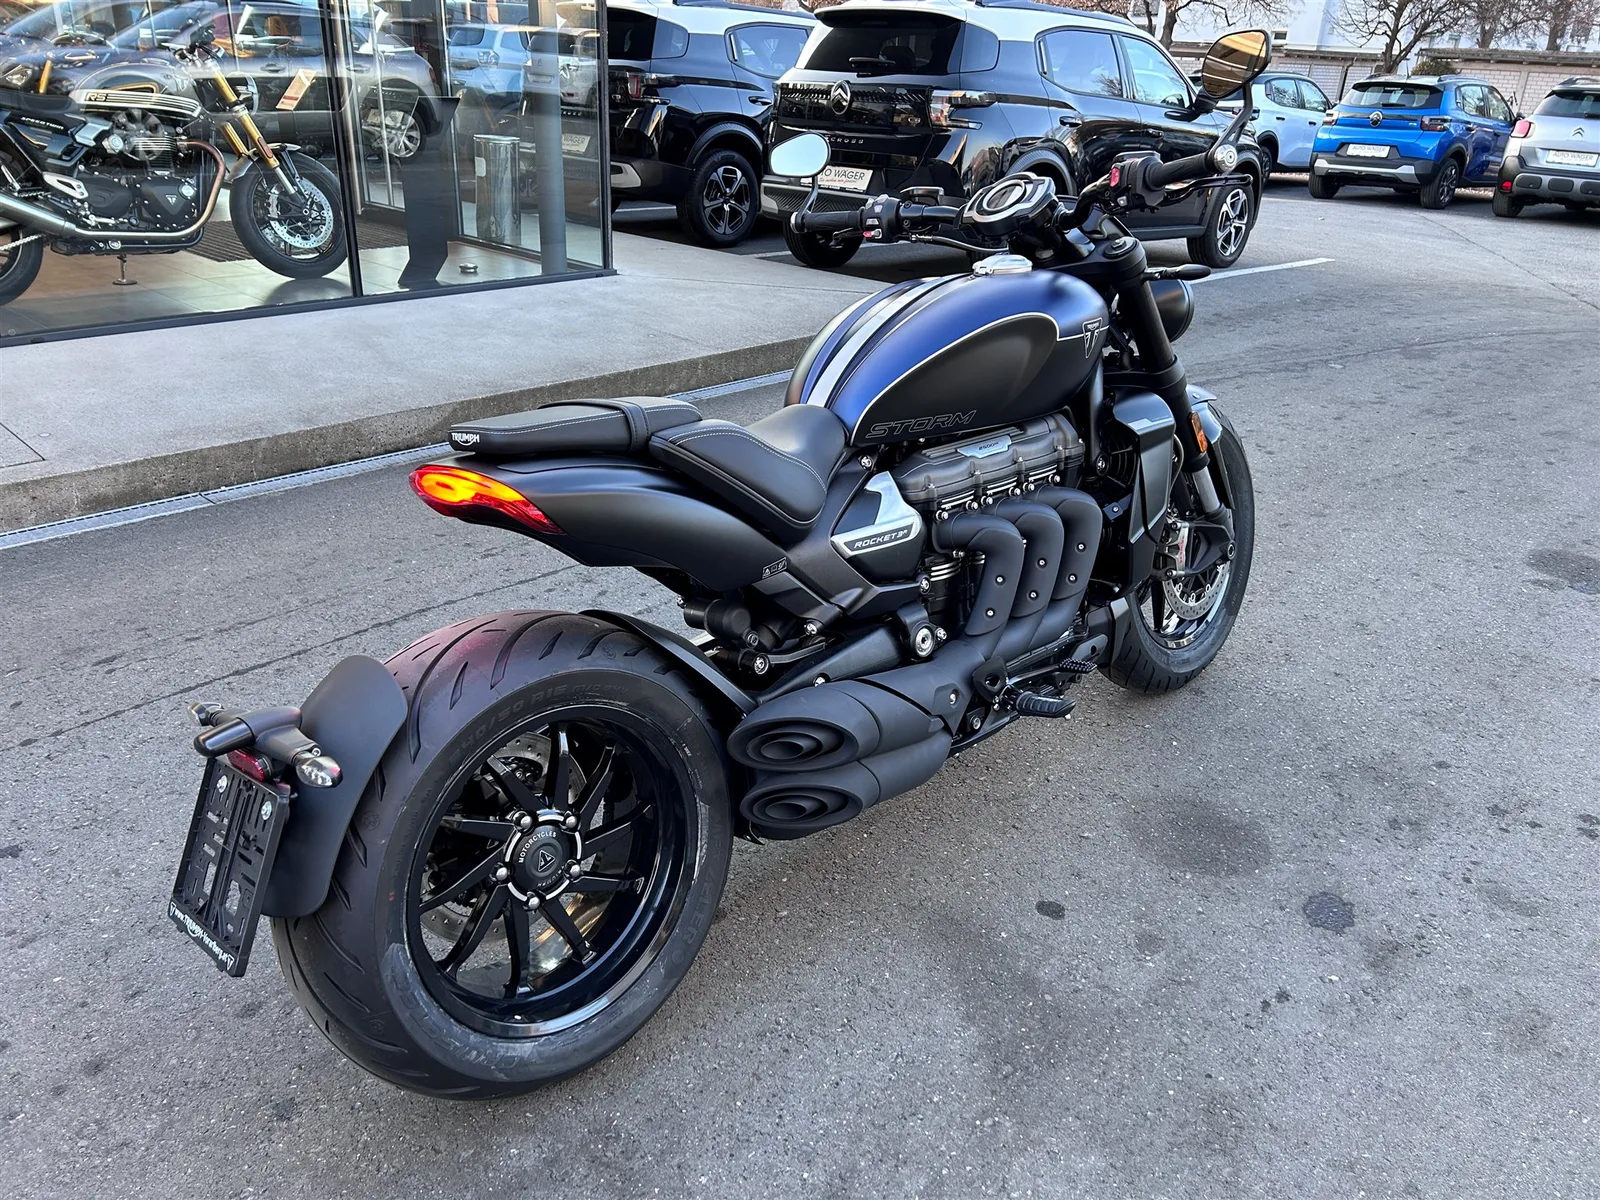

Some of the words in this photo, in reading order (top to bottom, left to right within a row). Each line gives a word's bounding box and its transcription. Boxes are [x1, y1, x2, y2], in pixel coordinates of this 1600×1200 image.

[86, 92, 106, 102] RS
[865, 409, 978, 439] STORM
[451, 432, 480, 445] TRIUMPH
[518, 830, 557, 863] MOTORCYCLES
